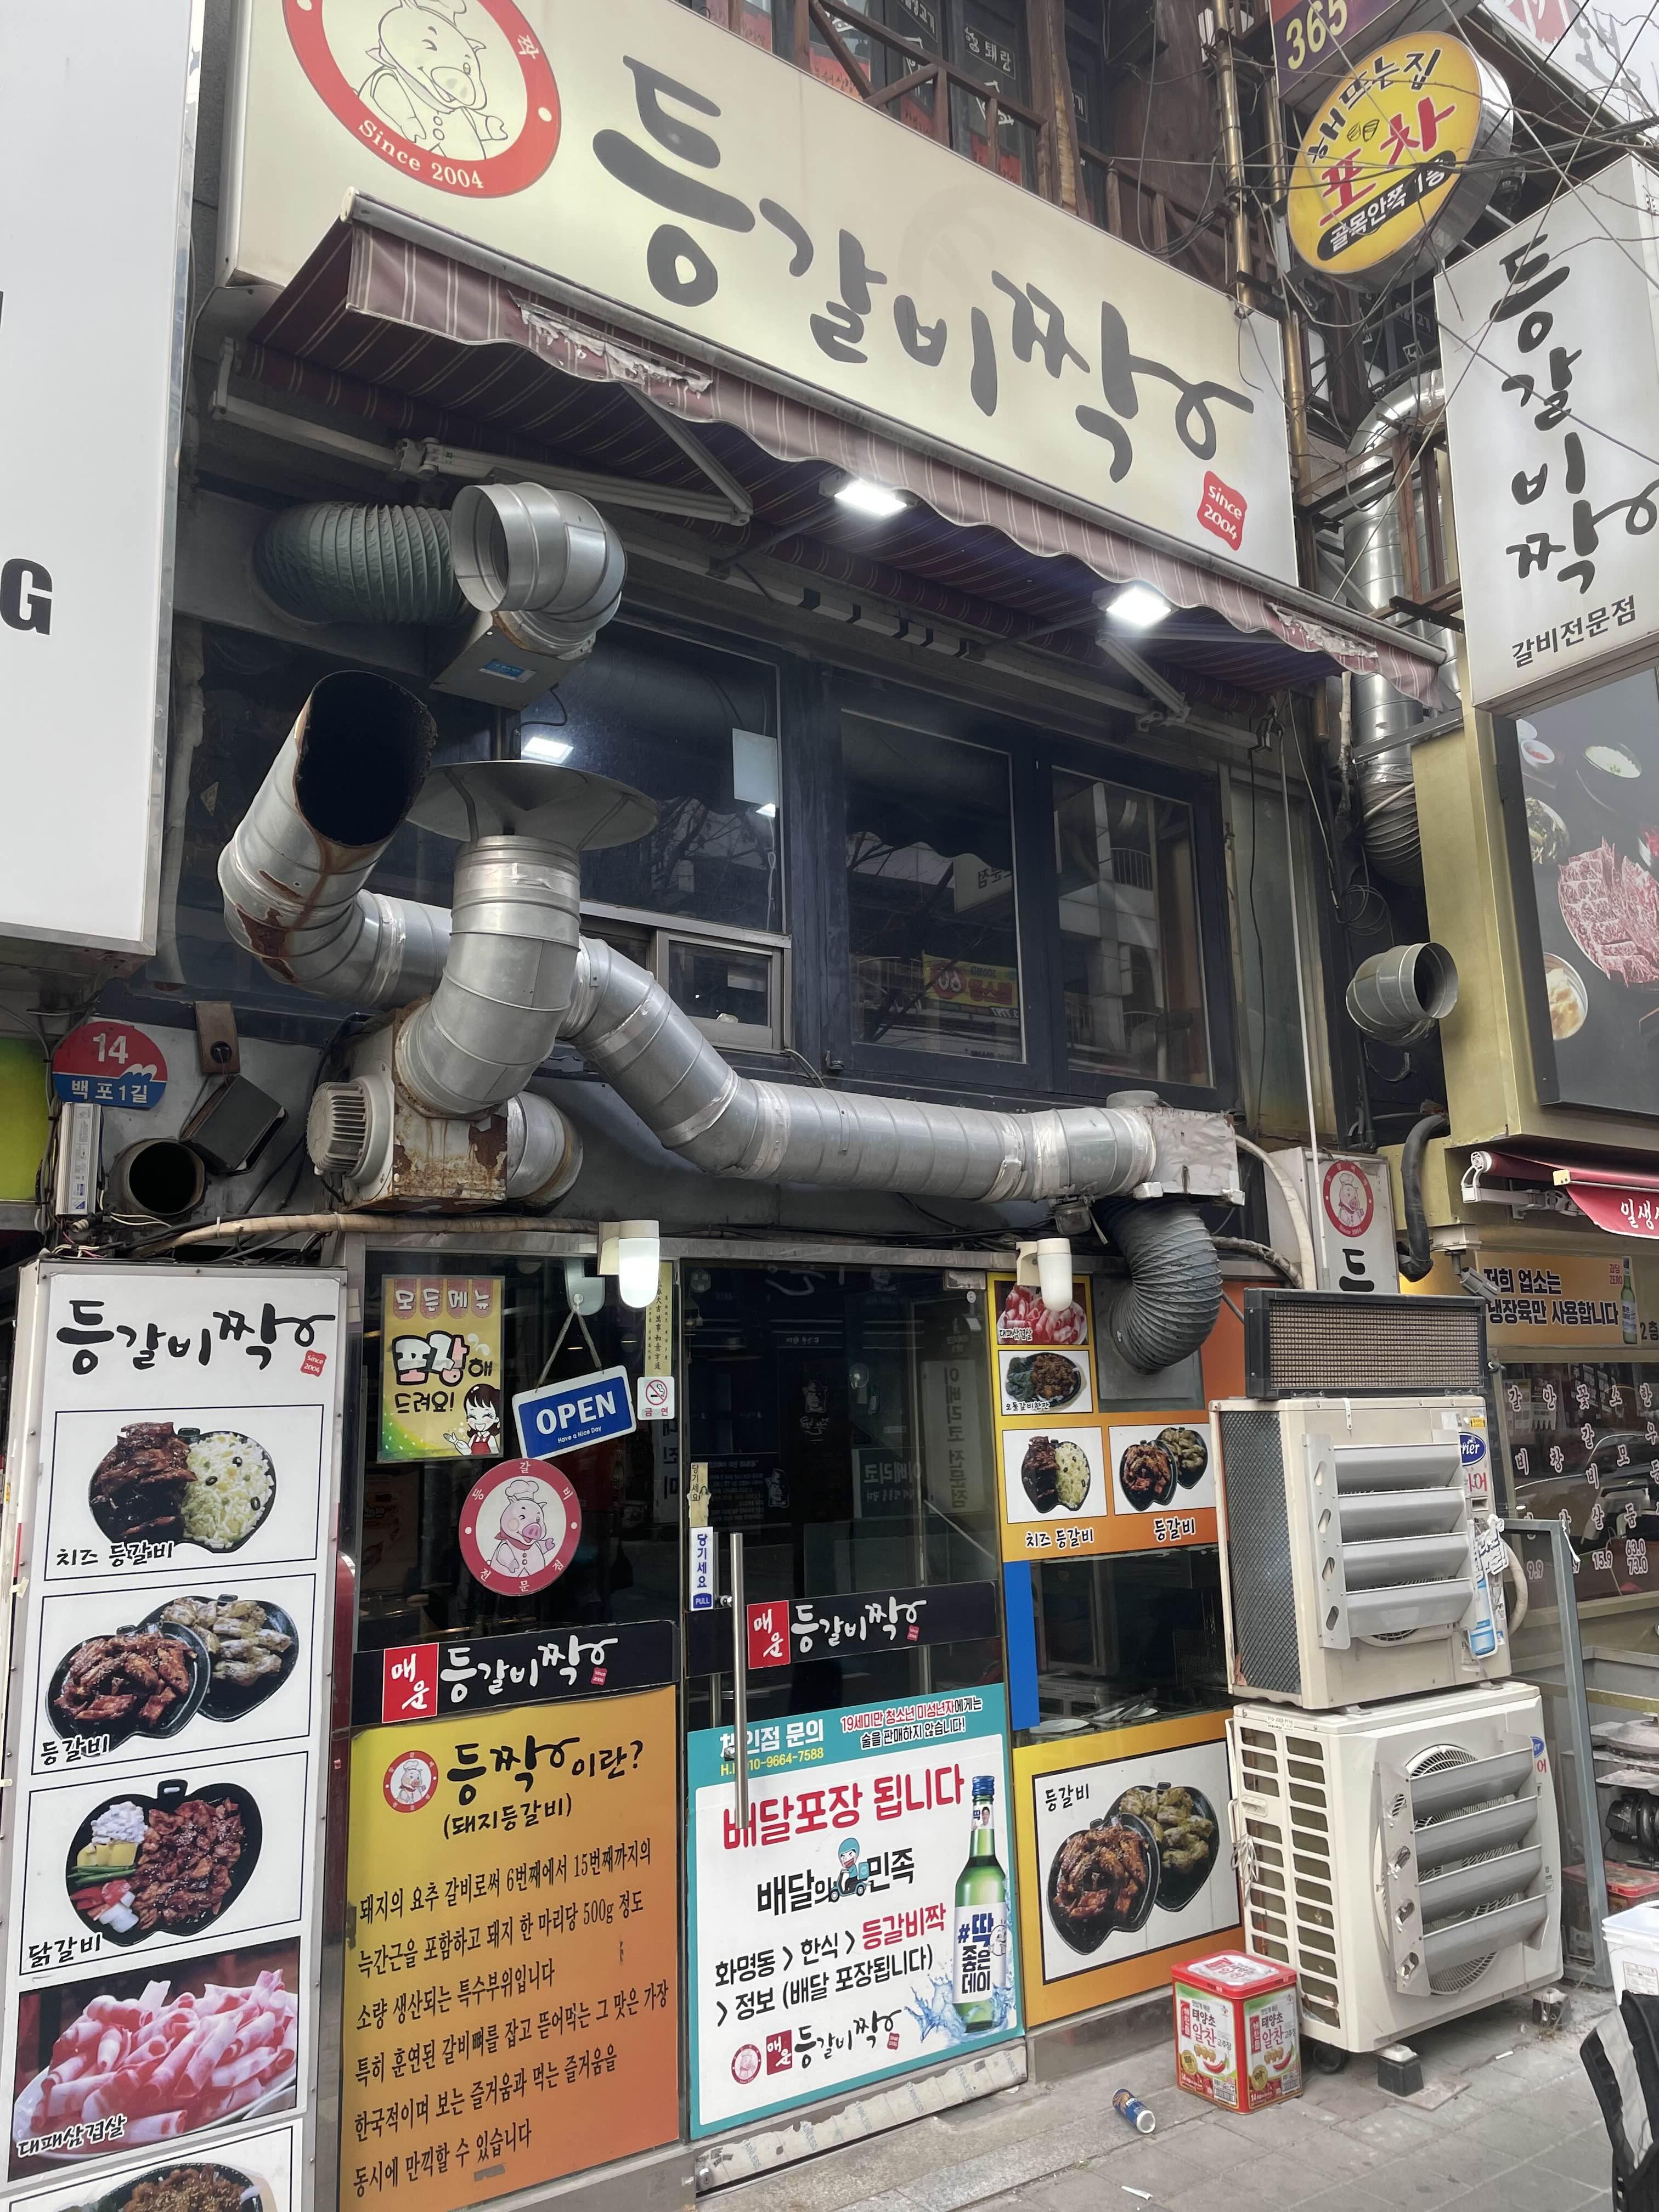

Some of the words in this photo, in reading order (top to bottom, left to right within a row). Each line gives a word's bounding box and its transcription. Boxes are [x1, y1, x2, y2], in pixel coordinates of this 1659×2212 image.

[1285, 0, 1348, 70] 365
[358, 119, 421, 171] Since
[432, 161, 485, 190] 2004
[1319, 97, 1457, 228] 포차
[1329, 189, 1408, 253] 골목안쪽
[592, 54, 1254, 483] 등갈비짝
[1489, 233, 1659, 595] 등갈비짝
[1206, 485, 1244, 521] since
[1203, 503, 1240, 540] 2004
[1511, 594, 1637, 669] 갈비전문점
[92, 1032, 129, 1065] 14
[71, 1079, 148, 1104] 백포1길
[1483, 1268, 1515, 1294] 저희
[1518, 1269, 1562, 1295] 업소는
[1487, 1299, 1547, 1325] 냉장육만
[1551, 1300, 1620, 1327] 사용합니다
[57, 1300, 336, 1375] 등갈비짝
[999, 1327, 1033, 1341] 대패삼겹살
[1640, 1321, 1659, 1341] 2층
[303, 1362, 321, 1374] 2004
[306, 1354, 324, 1364] since
[468, 1359, 493, 1378] 해
[394, 1391, 455, 1414] 드려요!
[536, 1391, 617, 1435] OPEN
[644, 1406, 669, 1418] 금연
[557, 1436, 572, 1444] Have
[578, 1430, 591, 1438] Nice
[1462, 1439, 1480, 1455] rier
[472, 1460, 574, 1502] 등갈비
[691, 1464, 701, 1503] 당기세요
[1025, 1531, 1051, 1548] 치즈
[1056, 1526, 1094, 1550] 등갈비
[1153, 1517, 1195, 1543] 등갈비
[56, 1548, 99, 1566] 치즈
[109, 1541, 175, 1567] 등갈비
[696, 1534, 708, 1589] 당기세요
[1592, 1550, 1613, 1571] 15.9
[1626, 1538, 1646, 1556] 63.0
[479, 1560, 565, 1592] 전문점
[1527, 1560, 1544, 1580] 9.9
[1627, 1556, 1648, 1575] 73.0
[695, 1596, 710, 1606] PULL
[753, 1609, 784, 1658] 매운
[791, 1595, 928, 1654] 등갈비짝
[391, 1653, 430, 1711] 매운
[440, 1635, 619, 1703] 등갈비짝
[840, 1709, 884, 1734] 19세미만
[885, 1704, 916, 1728] 청소년
[917, 1696, 983, 1724] 미성년자에게는
[786, 1718, 824, 1748] 문의
[861, 1733, 882, 1749] 술을
[883, 1726, 923, 1746] 판매하지
[924, 1718, 966, 1741] 않습니다!
[40, 1734, 111, 1767] 등갈비
[720, 1762, 736, 1776] H.
[747, 1747, 824, 1771] 10-9664-7588
[723, 1783, 863, 1850] 배달포장
[873, 1763, 965, 1821] 됩니다
[1045, 1785, 1091, 1812] 등갈비
[443, 1793, 573, 1839] (돼지등갈비)
[359, 1888, 404, 1923] 돼지의
[409, 1882, 439, 1912] 요추
[445, 1869, 501, 1906] 갈비로써
[506, 1854, 567, 1892] 6번째에서
[573, 1837, 652, 1878] 15번째까지의
[866, 1847, 916, 1892] 민족
[28, 1932, 102, 1968] 닭갈비
[358, 1938, 419, 1978] 늑간근을
[424, 1927, 482, 1962] 포함하고
[487, 1916, 514, 1949] 돼지
[520, 1914, 533, 1941] 한
[539, 1901, 579, 1933] 마리당
[583, 1899, 615, 1925] 500g
[618, 1890, 645, 1920] 정도
[714, 1948, 775, 1988] 화명동
[800, 1933, 839, 1963] 한식
[862, 1902, 947, 1951] 등갈비짝
[962, 1945, 991, 1971] 좋은
[356, 1999, 388, 2030] 소량
[392, 1985, 453, 2024] 생산되는
[456, 1957, 556, 2007] 특수부위입니다
[735, 1987, 775, 2021] 정보
[782, 1971, 830, 2011] (배달
[836, 1943, 934, 1993] 포장됩니다)
[961, 1971, 991, 1995] 데이
[354, 2051, 385, 2088] 특히
[390, 2039, 437, 2077] 훈연된
[442, 2023, 500, 2066] 갈비뼈를
[504, 2017, 533, 2049] 잡고
[537, 2002, 591, 2037] 뜯어먹는
[595, 1999, 610, 2021] 그
[613, 1987, 641, 2021] 맛은
[644, 1978, 669, 2011] 가장
[1192, 2009, 1216, 2028] 태양초
[1261, 2013, 1284, 2028] 태양초
[794, 2008, 902, 2070] 등갈비짝
[1193, 2023, 1217, 2049] 알찬
[1217, 2038, 1232, 2051] 고추장
[1262, 2025, 1284, 2050] 알찬
[354, 2094, 430, 2143] 한국적이며
[435, 2087, 466, 2119] 보는
[470, 2067, 527, 2111] 즐거움과
[532, 2061, 560, 2092] 먹는
[563, 2043, 618, 2083] 즐거움을
[16, 2114, 128, 2158] 대패삼겹살
[353, 2156, 399, 2199] 동시에
[405, 2142, 450, 2182] 만끽할
[455, 2137, 471, 2169] 수
[475, 2118, 533, 2163] 있습니다
